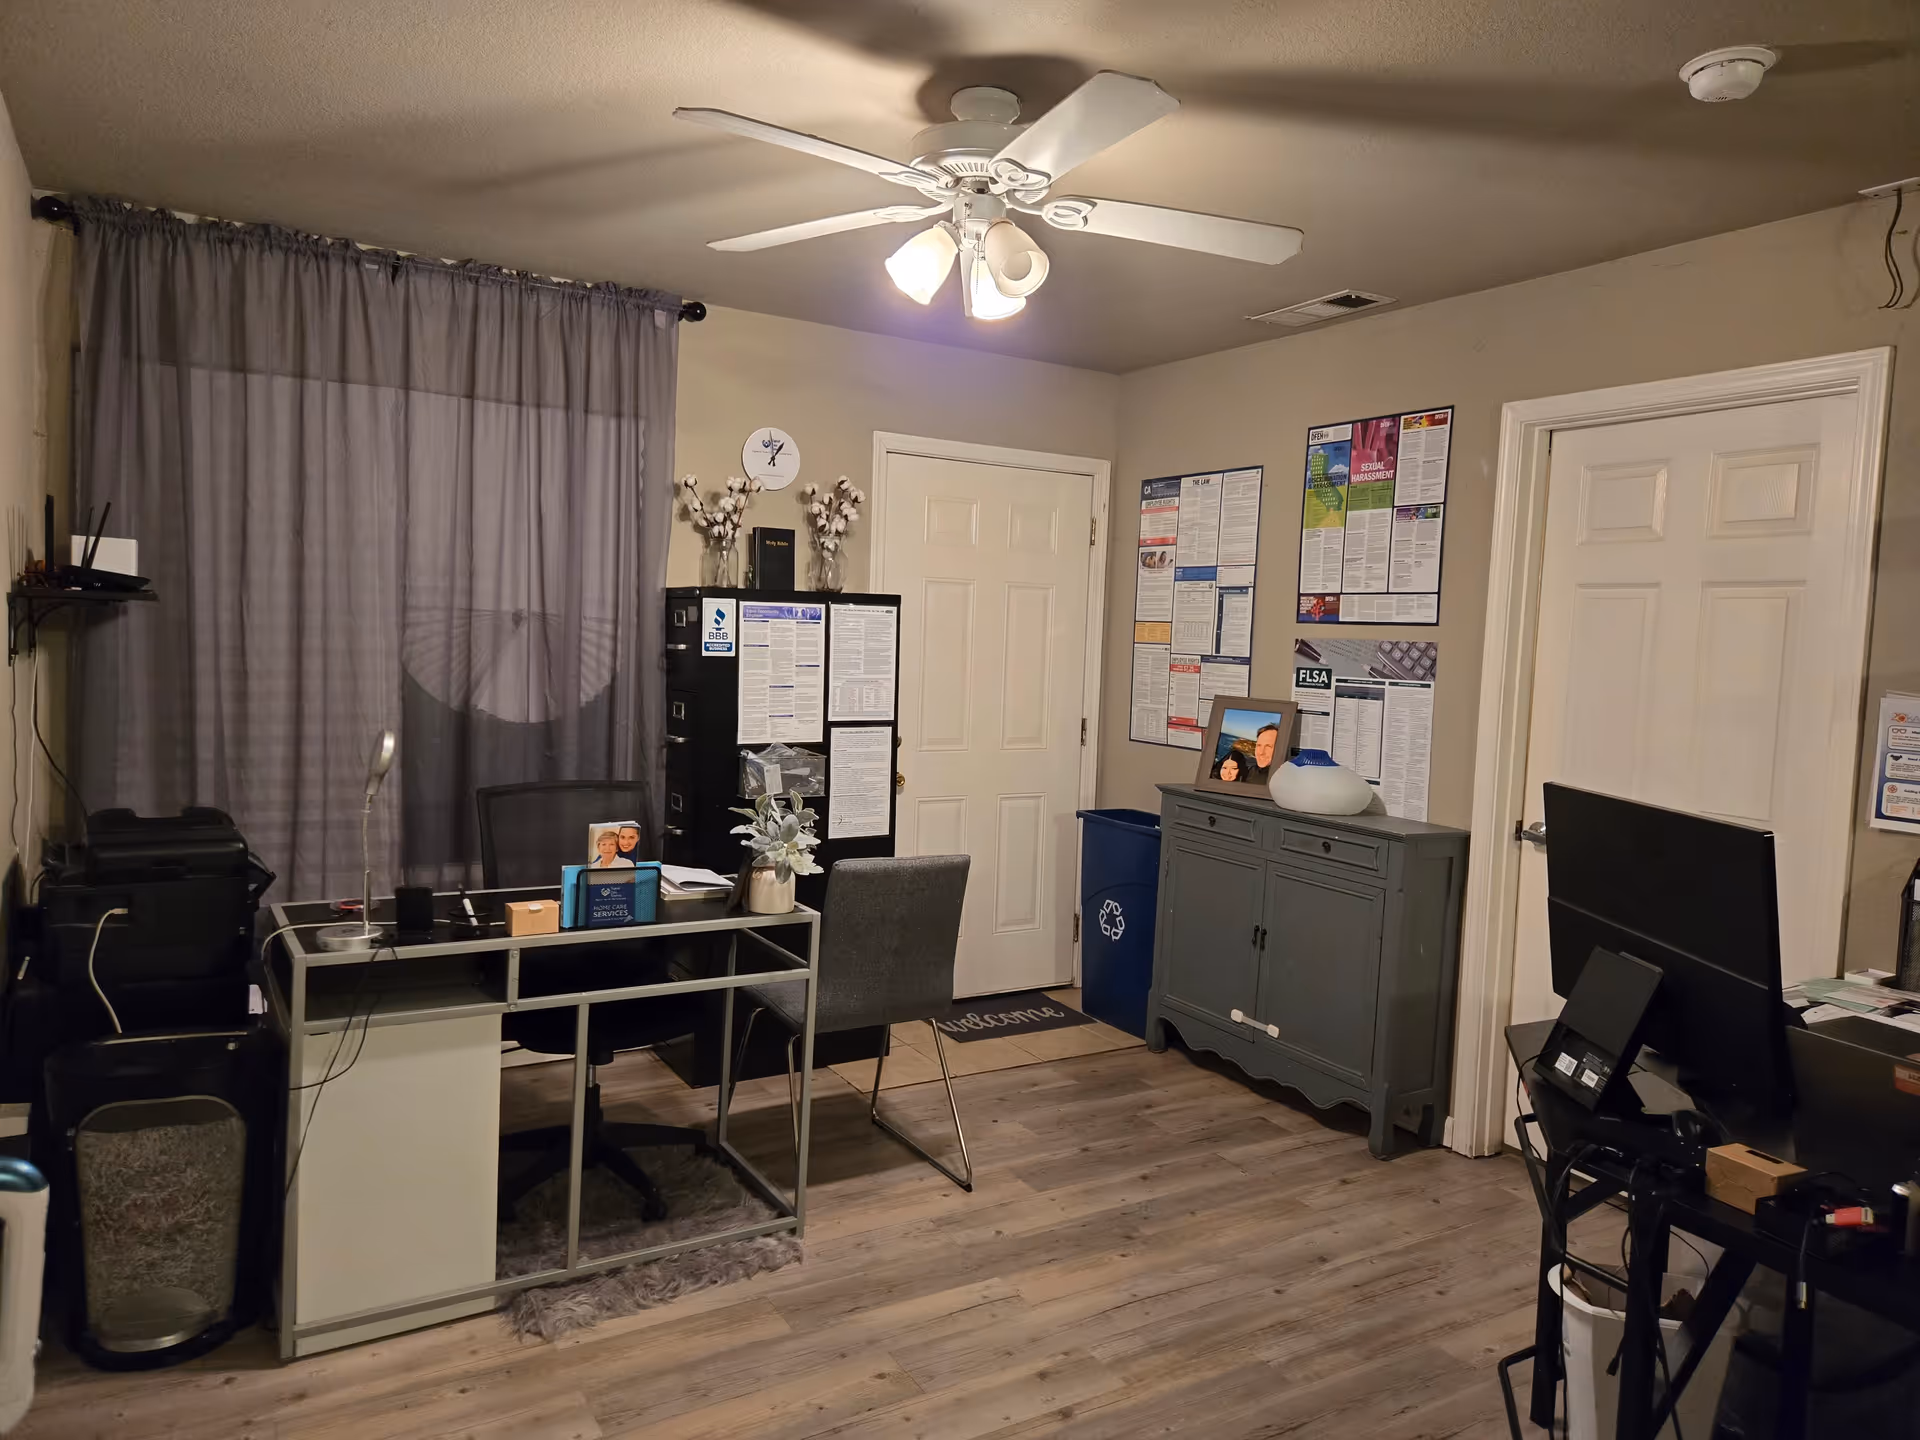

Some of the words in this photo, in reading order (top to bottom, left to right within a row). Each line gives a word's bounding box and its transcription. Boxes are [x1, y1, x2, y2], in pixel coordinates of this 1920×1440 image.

[1360, 461, 1385, 472] SEXUAL
[1351, 470, 1395, 482] HARASSMENT
[1144, 485, 1152, 495] CA
[708, 632, 729, 640] BBB
[1299, 669, 1329, 683] FLSA
[593, 910, 629, 918] SERVICES
[936, 1006, 1065, 1033] welcome
